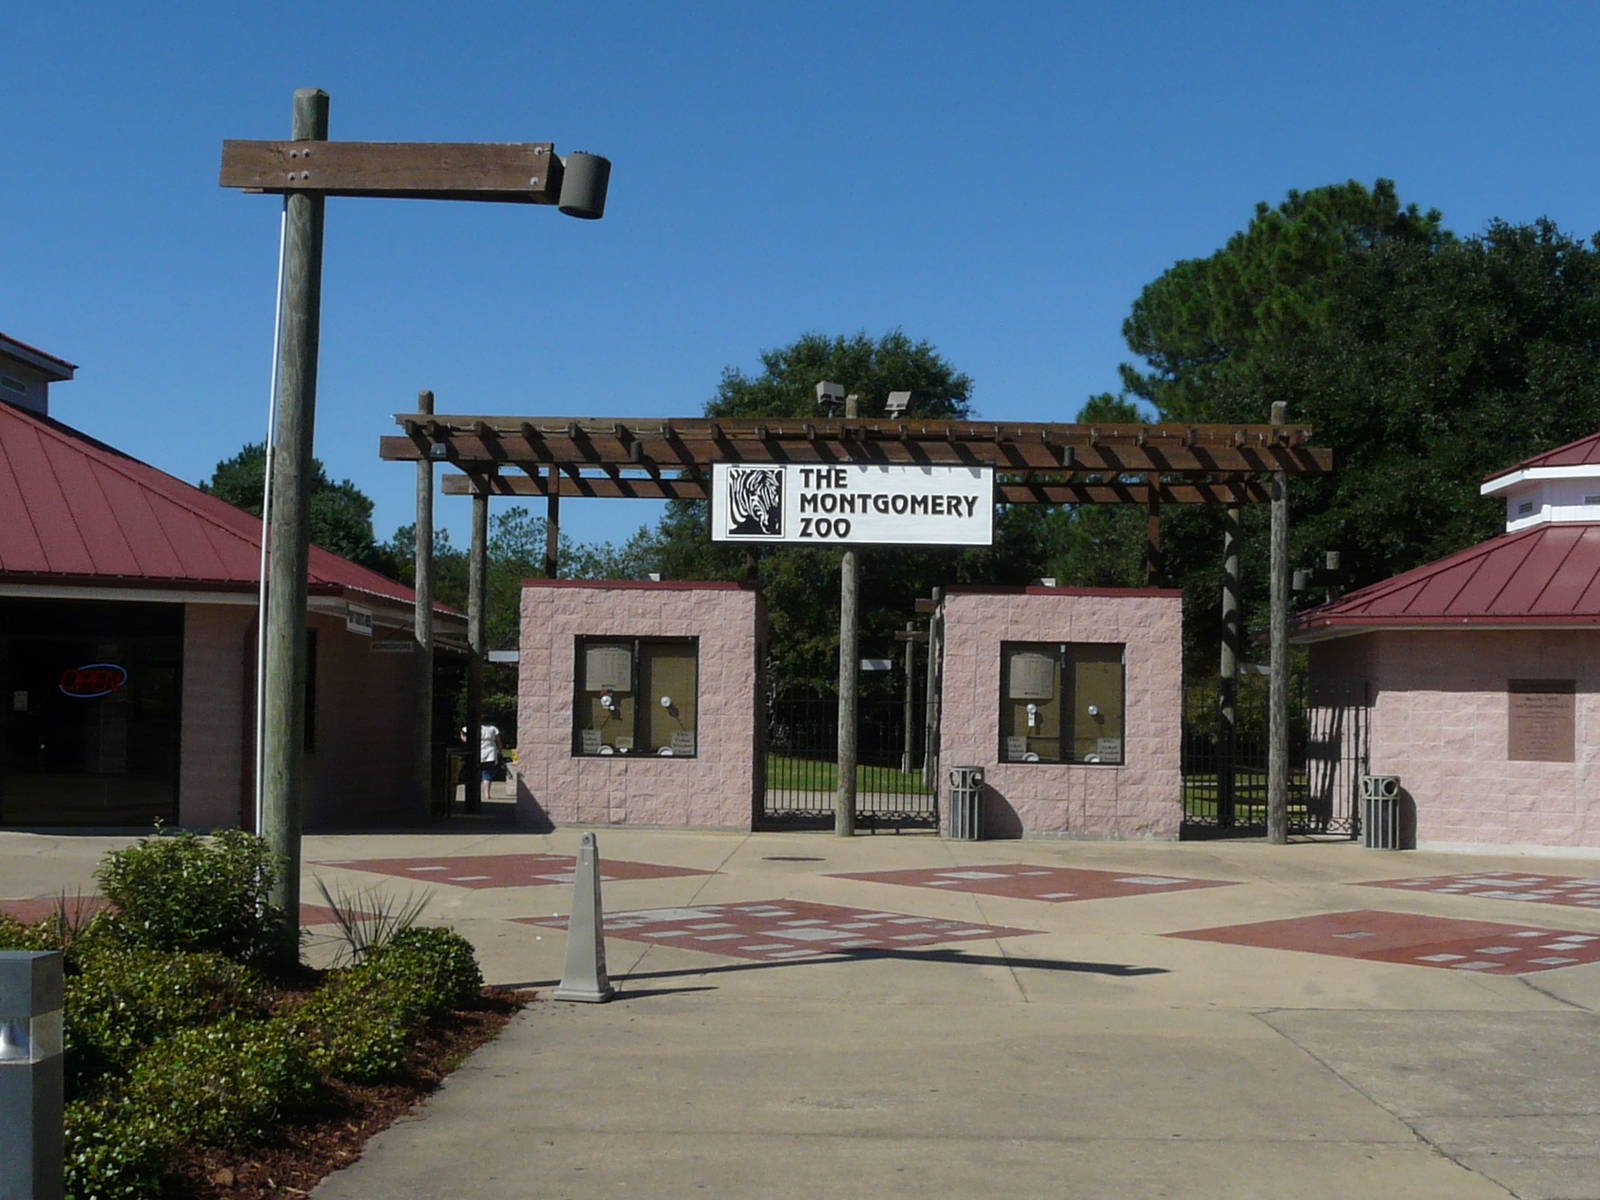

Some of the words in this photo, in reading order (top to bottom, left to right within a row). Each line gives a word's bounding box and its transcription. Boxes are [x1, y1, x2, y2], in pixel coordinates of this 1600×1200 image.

[800, 469, 848, 490] THE
[799, 494, 979, 518] MONTGOMERY
[799, 518, 851, 538] ZOO
[60, 667, 122, 692] OPEN
